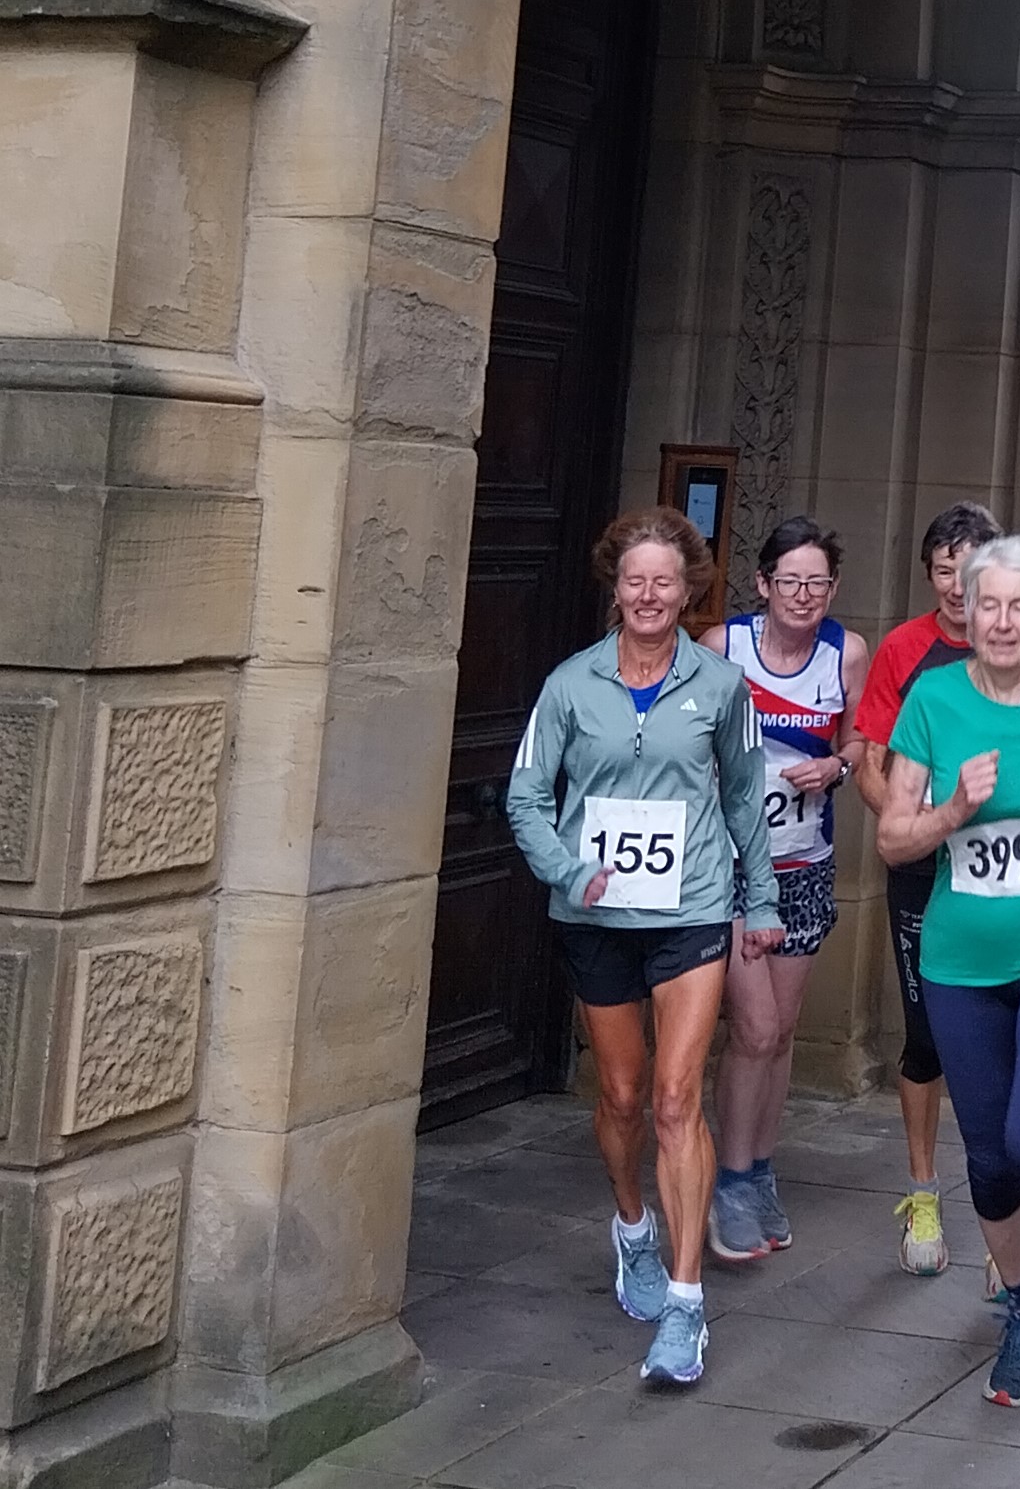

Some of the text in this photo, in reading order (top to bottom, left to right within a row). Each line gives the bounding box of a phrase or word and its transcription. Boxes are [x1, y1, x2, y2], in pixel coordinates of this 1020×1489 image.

[757, 713, 832, 728] MORDEN
[764, 790, 806, 828] 21
[590, 830, 675, 875] 155
[903, 953, 919, 1003] odlo
